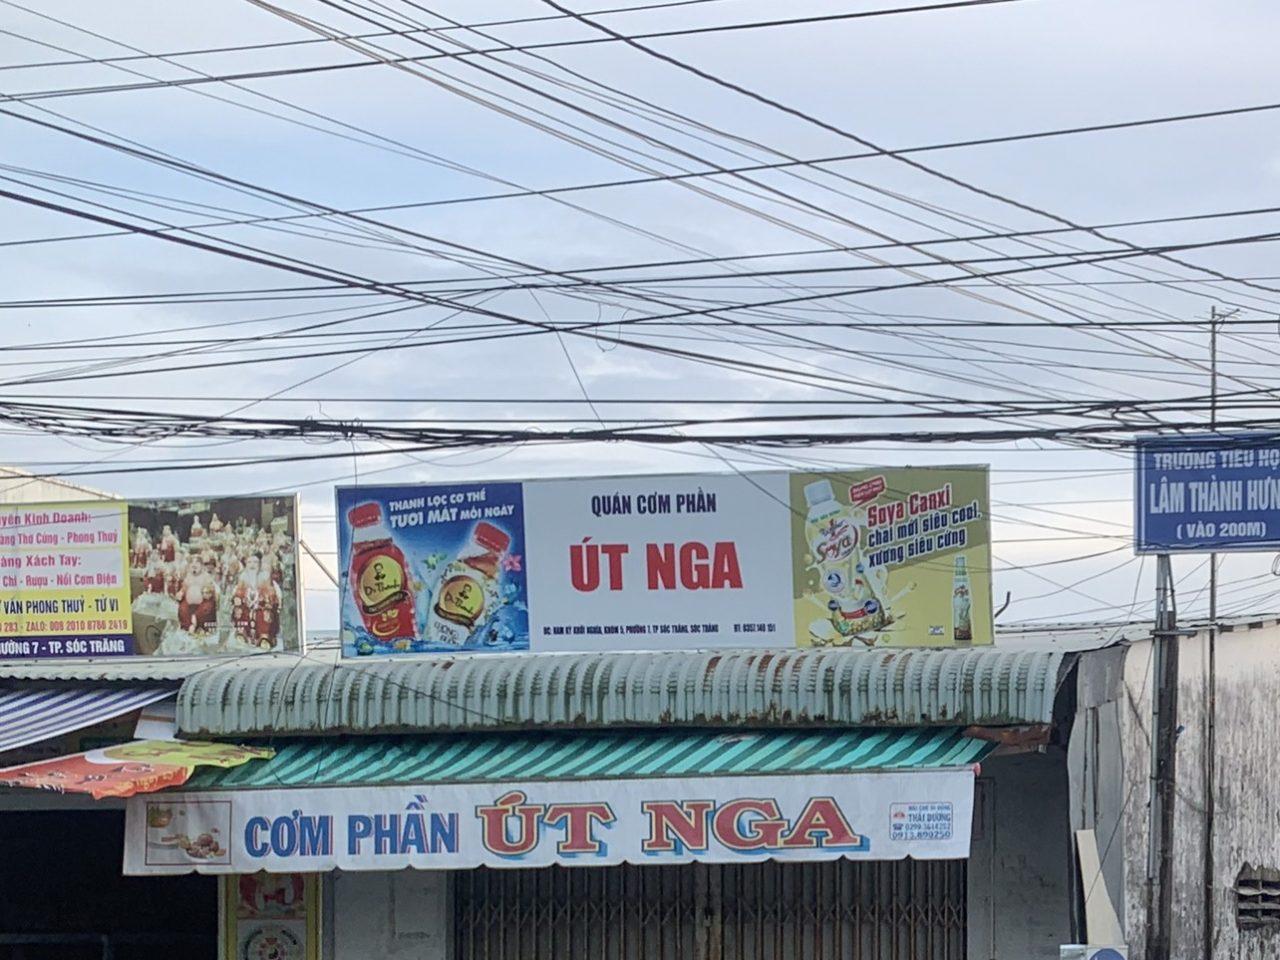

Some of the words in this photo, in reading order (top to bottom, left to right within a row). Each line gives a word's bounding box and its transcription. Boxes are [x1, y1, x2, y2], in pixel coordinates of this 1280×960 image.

[389, 500, 425, 512] THANH
[427, 494, 447, 507] LỌC
[591, 492, 632, 517] QUÁN
[636, 491, 671, 515] CƠM
[867, 502, 904, 528] Soya
[909, 485, 950, 515] Canxi
[1151, 476, 1185, 514] LÂM
[1189, 474, 1243, 513] THÀNH
[67, 531, 95, 544] Phong
[868, 528, 893, 548] chai
[897, 517, 919, 536] mới
[922, 512, 948, 531] siêu
[908, 536, 933, 554] siêu
[937, 527, 966, 549] cứng
[0, 556, 21, 569] àng
[26, 554, 55, 567] Xách
[59, 553, 82, 567] Tay:
[569, 536, 629, 592] ÚT
[646, 541, 743, 591] NGA
[26, 600, 58, 613] PHONG
[32, 641, 39, 653] 7
[49, 640, 63, 653] TP.
[66, 638, 88, 653] SÓC
[89, 636, 125, 652] TRĂNG
[244, 809, 334, 857] CƠM
[347, 794, 459, 855] PHẦN
[475, 790, 617, 859] ÚT
[642, 796, 870, 851] NGA
